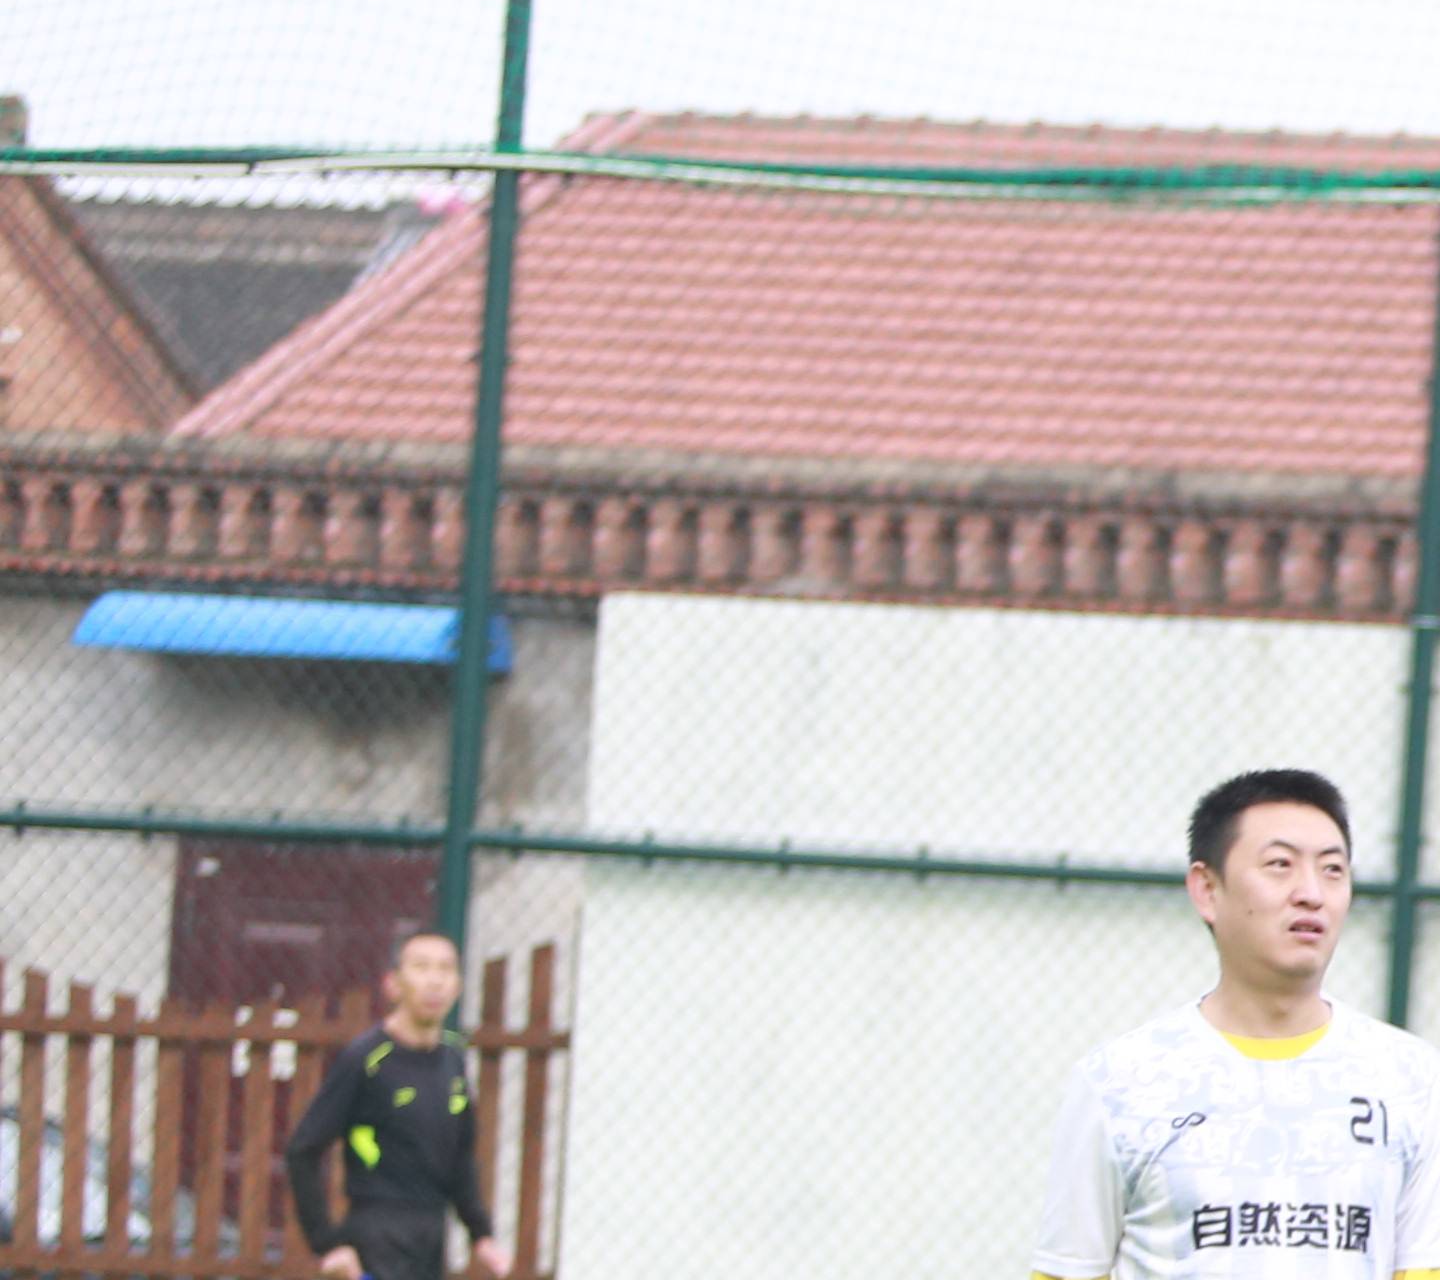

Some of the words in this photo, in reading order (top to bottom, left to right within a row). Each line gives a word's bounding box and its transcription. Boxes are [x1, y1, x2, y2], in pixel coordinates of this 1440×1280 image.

[1350, 1096, 1388, 1147] 21
[1193, 1201, 1371, 1253] 自然资源
